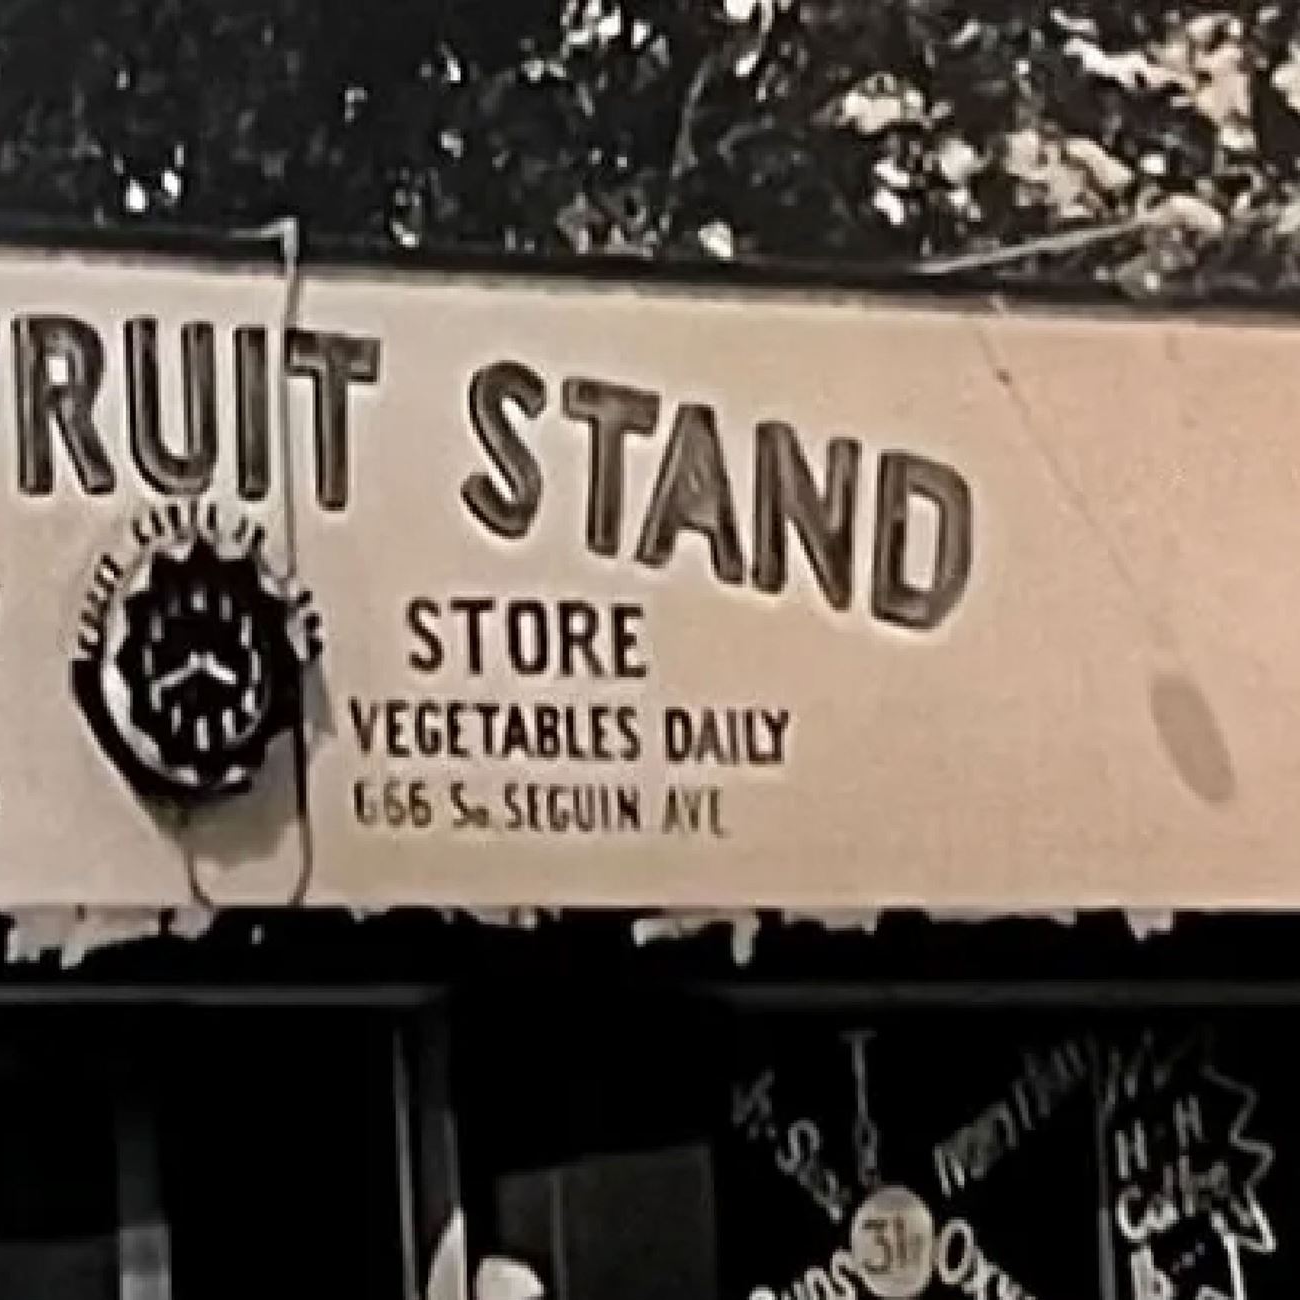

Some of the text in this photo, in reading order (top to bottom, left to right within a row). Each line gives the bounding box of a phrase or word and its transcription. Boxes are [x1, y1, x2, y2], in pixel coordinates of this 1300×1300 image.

[460, 358, 975, 632] STAND
[407, 600, 650, 680] STORE
[349, 698, 641, 764] VEGETABLES
[664, 706, 791, 768] DAILY
